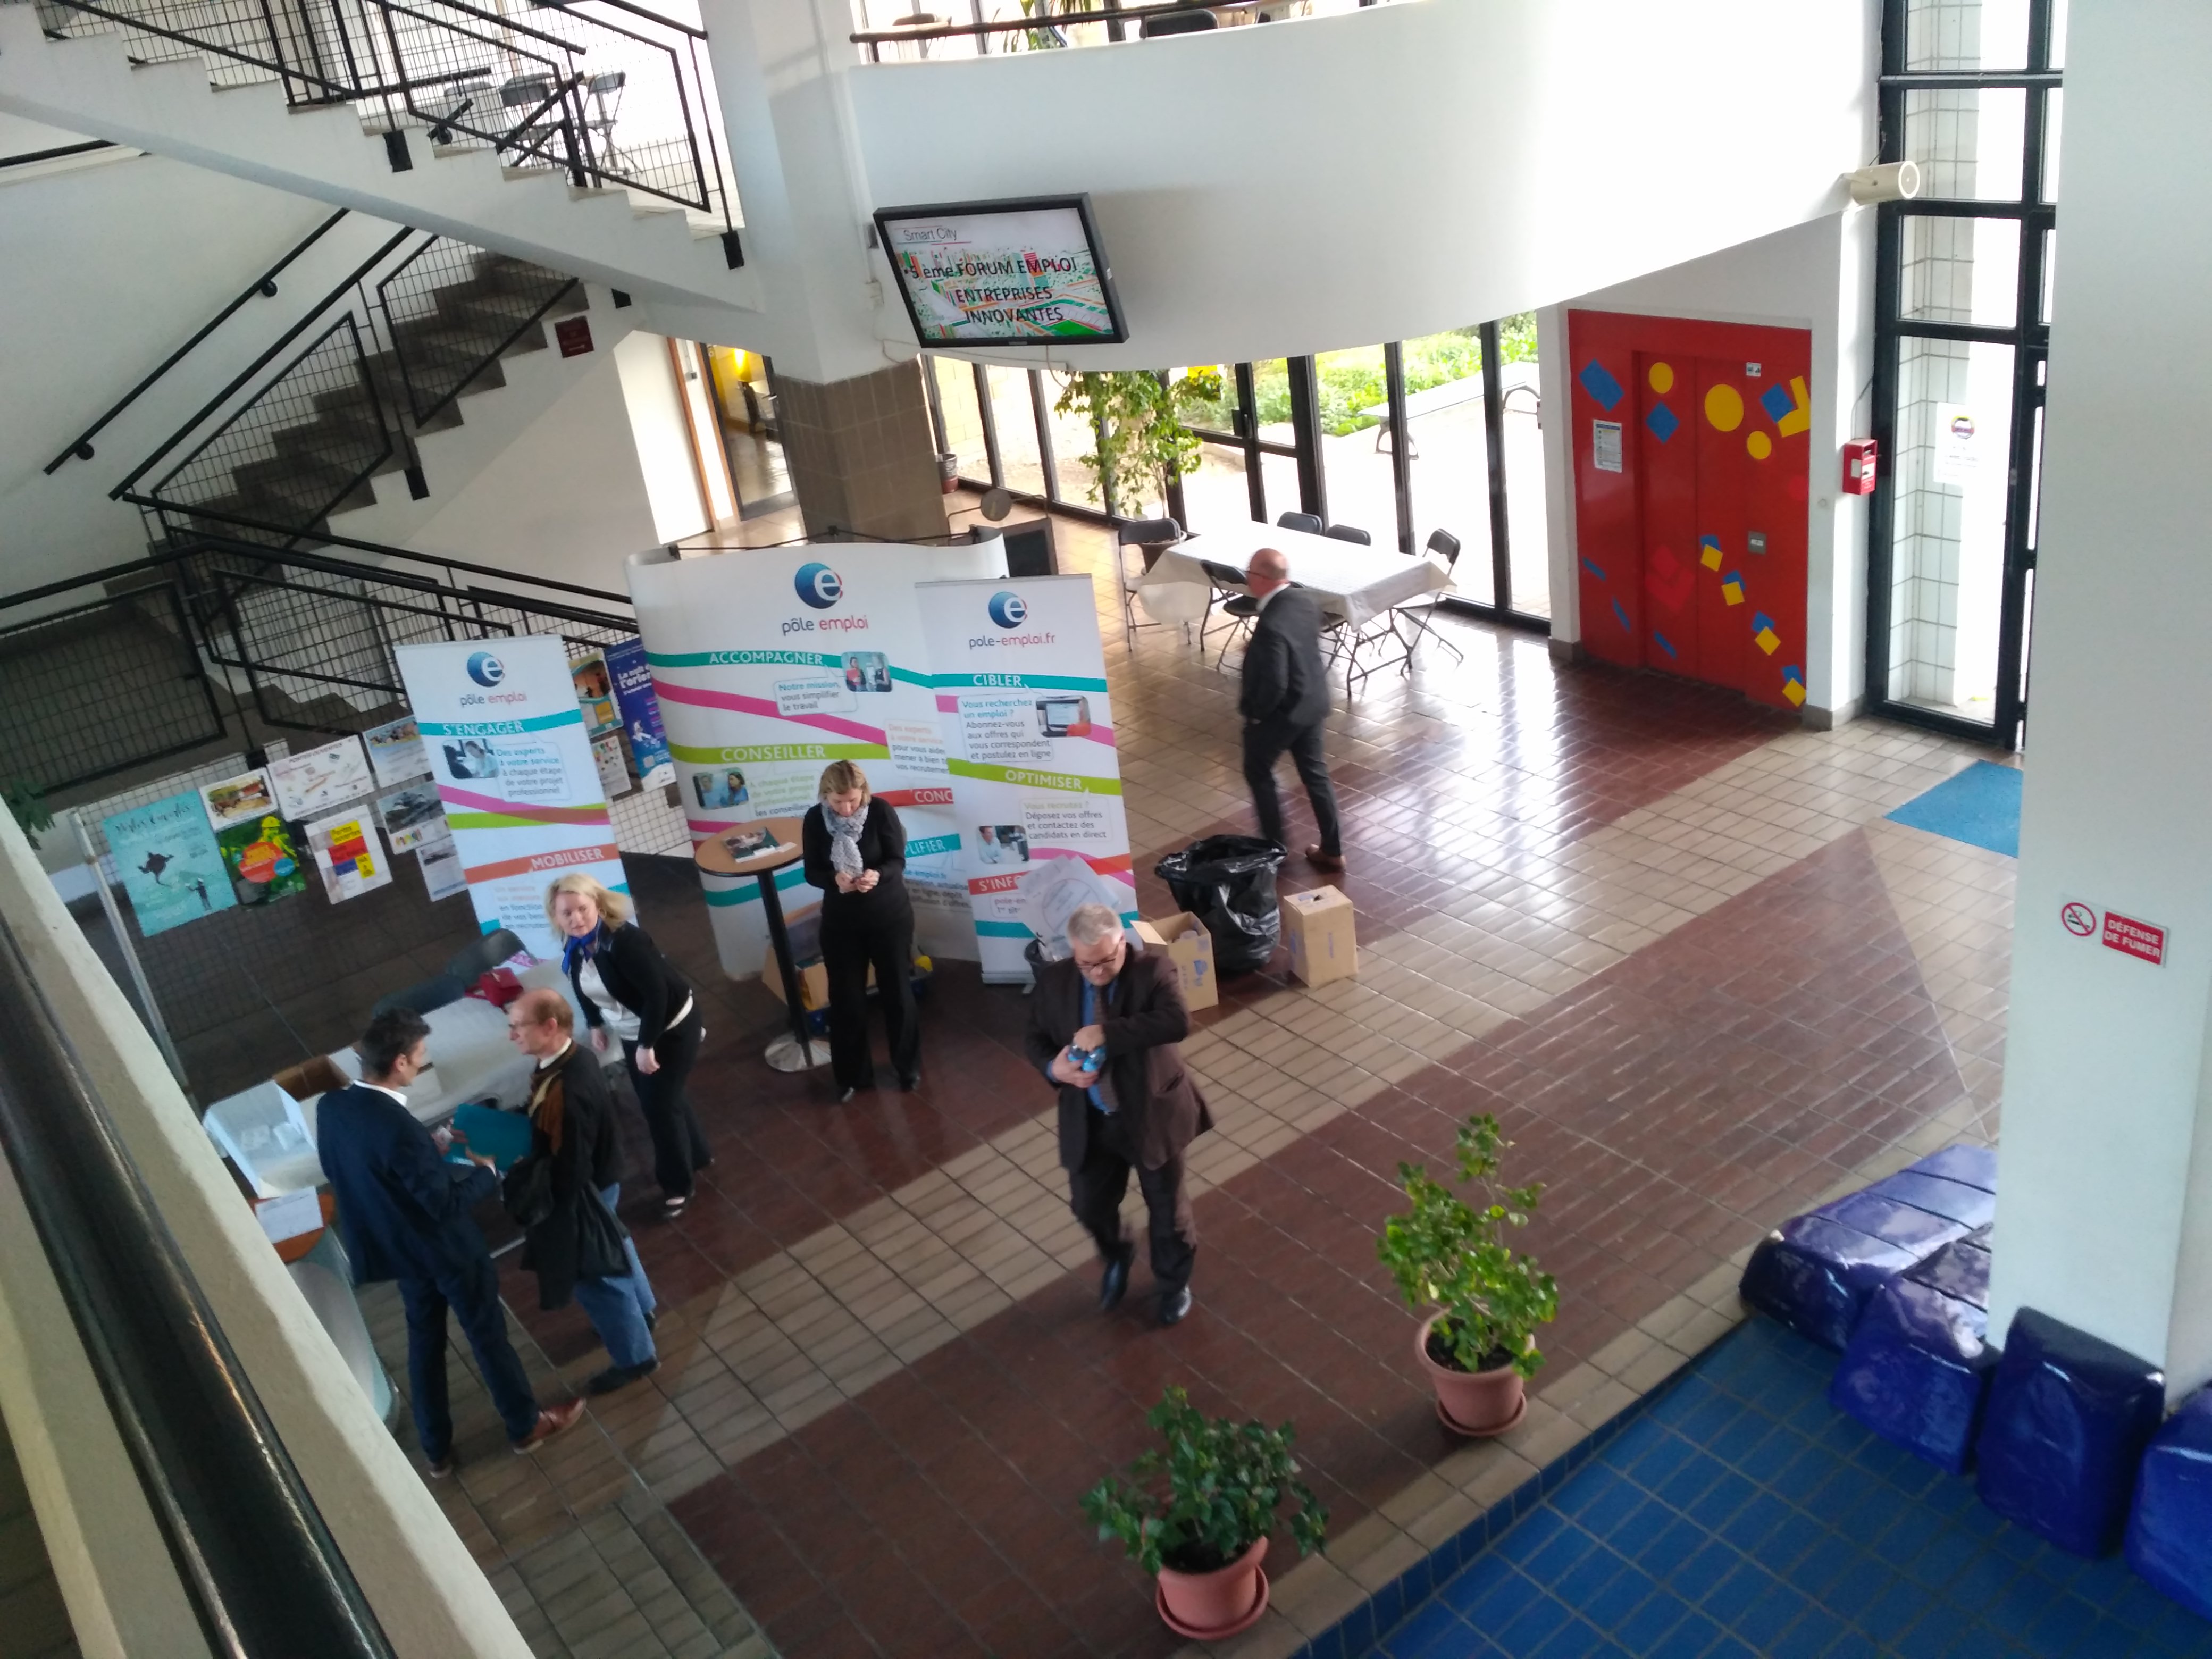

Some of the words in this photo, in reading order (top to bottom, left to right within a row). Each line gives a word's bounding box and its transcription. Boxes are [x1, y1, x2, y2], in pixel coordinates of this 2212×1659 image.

[904, 228, 934, 241] Smart
[937, 227, 957, 241] City
[957, 260, 1015, 276] FORUM
[1018, 257, 1077, 274] EMPLOI
[956, 286, 1053, 304] ENTREPRISES
[966, 306, 1064, 324] INNOVANTES
[782, 618, 815, 636] pôle
[819, 615, 869, 633] emploi
[968, 632, 1055, 650] pole-emploi.fr
[709, 650, 823, 666] ACCOMPAGNER
[973, 674, 1023, 687] CIBLER
[460, 694, 485, 708] pôle
[489, 692, 527, 706] emploi
[802, 691, 839, 701] simplifier
[793, 701, 818, 710] travail
[977, 710, 1008, 719] emploi
[443, 720, 525, 735] S'ENGAGER
[1011, 731, 1024, 739] qui
[991, 740, 1051, 749] correspondent
[722, 745, 826, 761] CONSEILLER
[982, 750, 1016, 760] postulez
[1031, 750, 1051, 759] ligne
[1004, 770, 1082, 790] OPTIMISER
[1026, 811, 1060, 820] Déposez
[531, 848, 605, 869] MOBILISER
[2104, 929, 2119, 943] DE
[2121, 936, 2161, 958] FUMER
